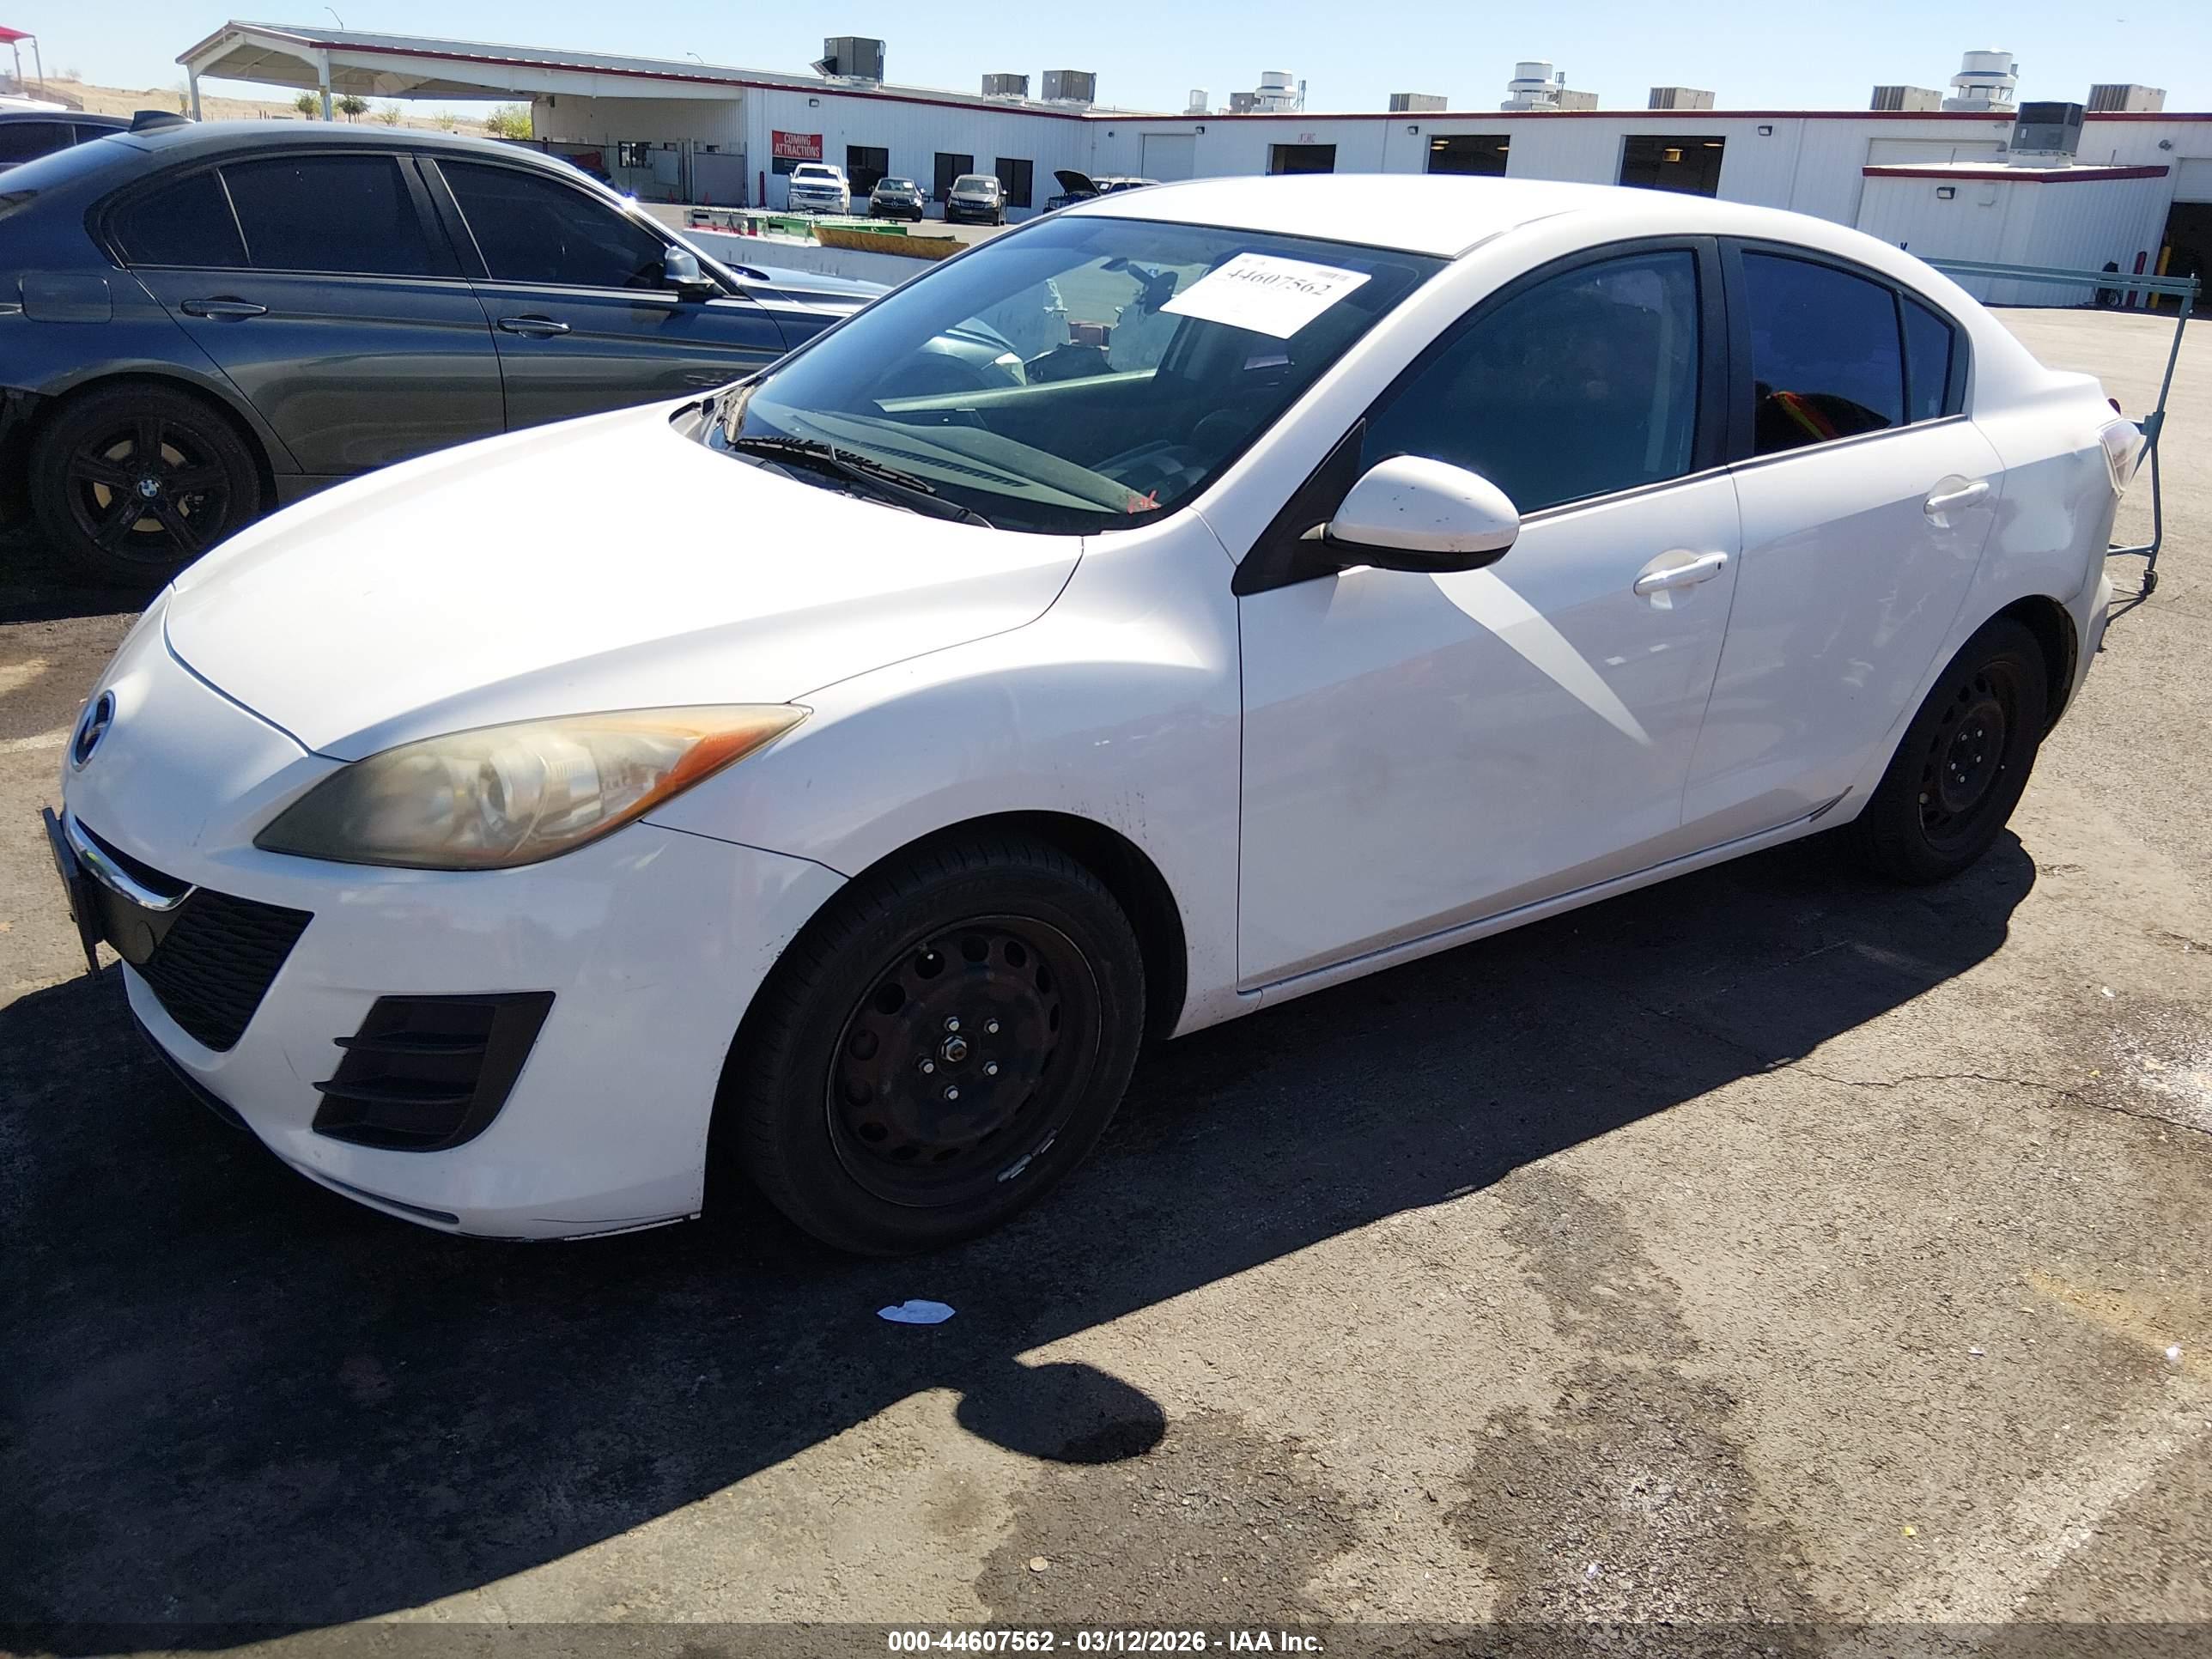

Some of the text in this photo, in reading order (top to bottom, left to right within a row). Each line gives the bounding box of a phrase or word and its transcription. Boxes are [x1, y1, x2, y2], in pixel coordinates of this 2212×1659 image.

[784, 134, 811, 146] COMING
[775, 143, 820, 157] ATTRACTIONS
[1227, 268, 1332, 296] 44607562
